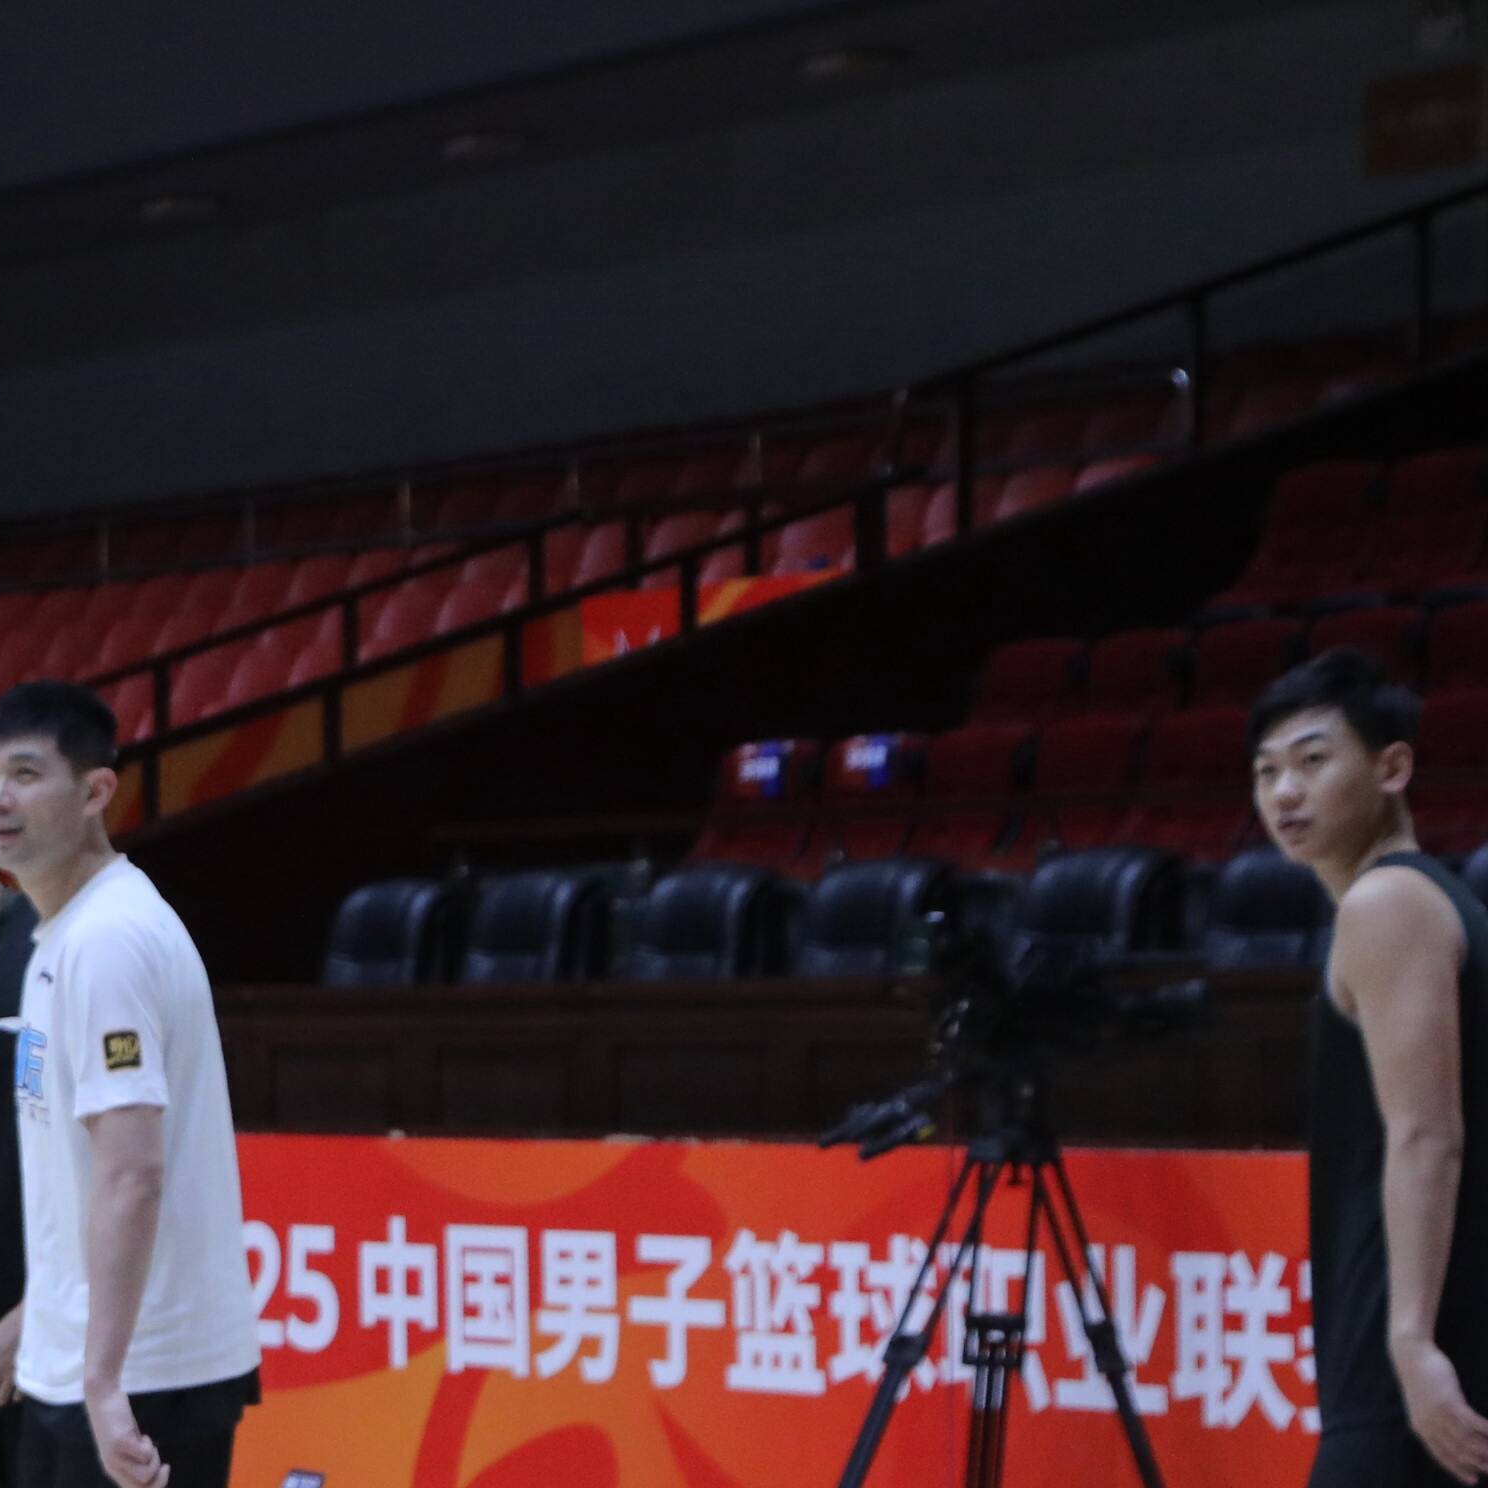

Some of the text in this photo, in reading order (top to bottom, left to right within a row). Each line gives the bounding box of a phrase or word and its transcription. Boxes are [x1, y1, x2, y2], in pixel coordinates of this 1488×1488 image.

[358, 1215, 1323, 1434] 中国男子篮球职业联
